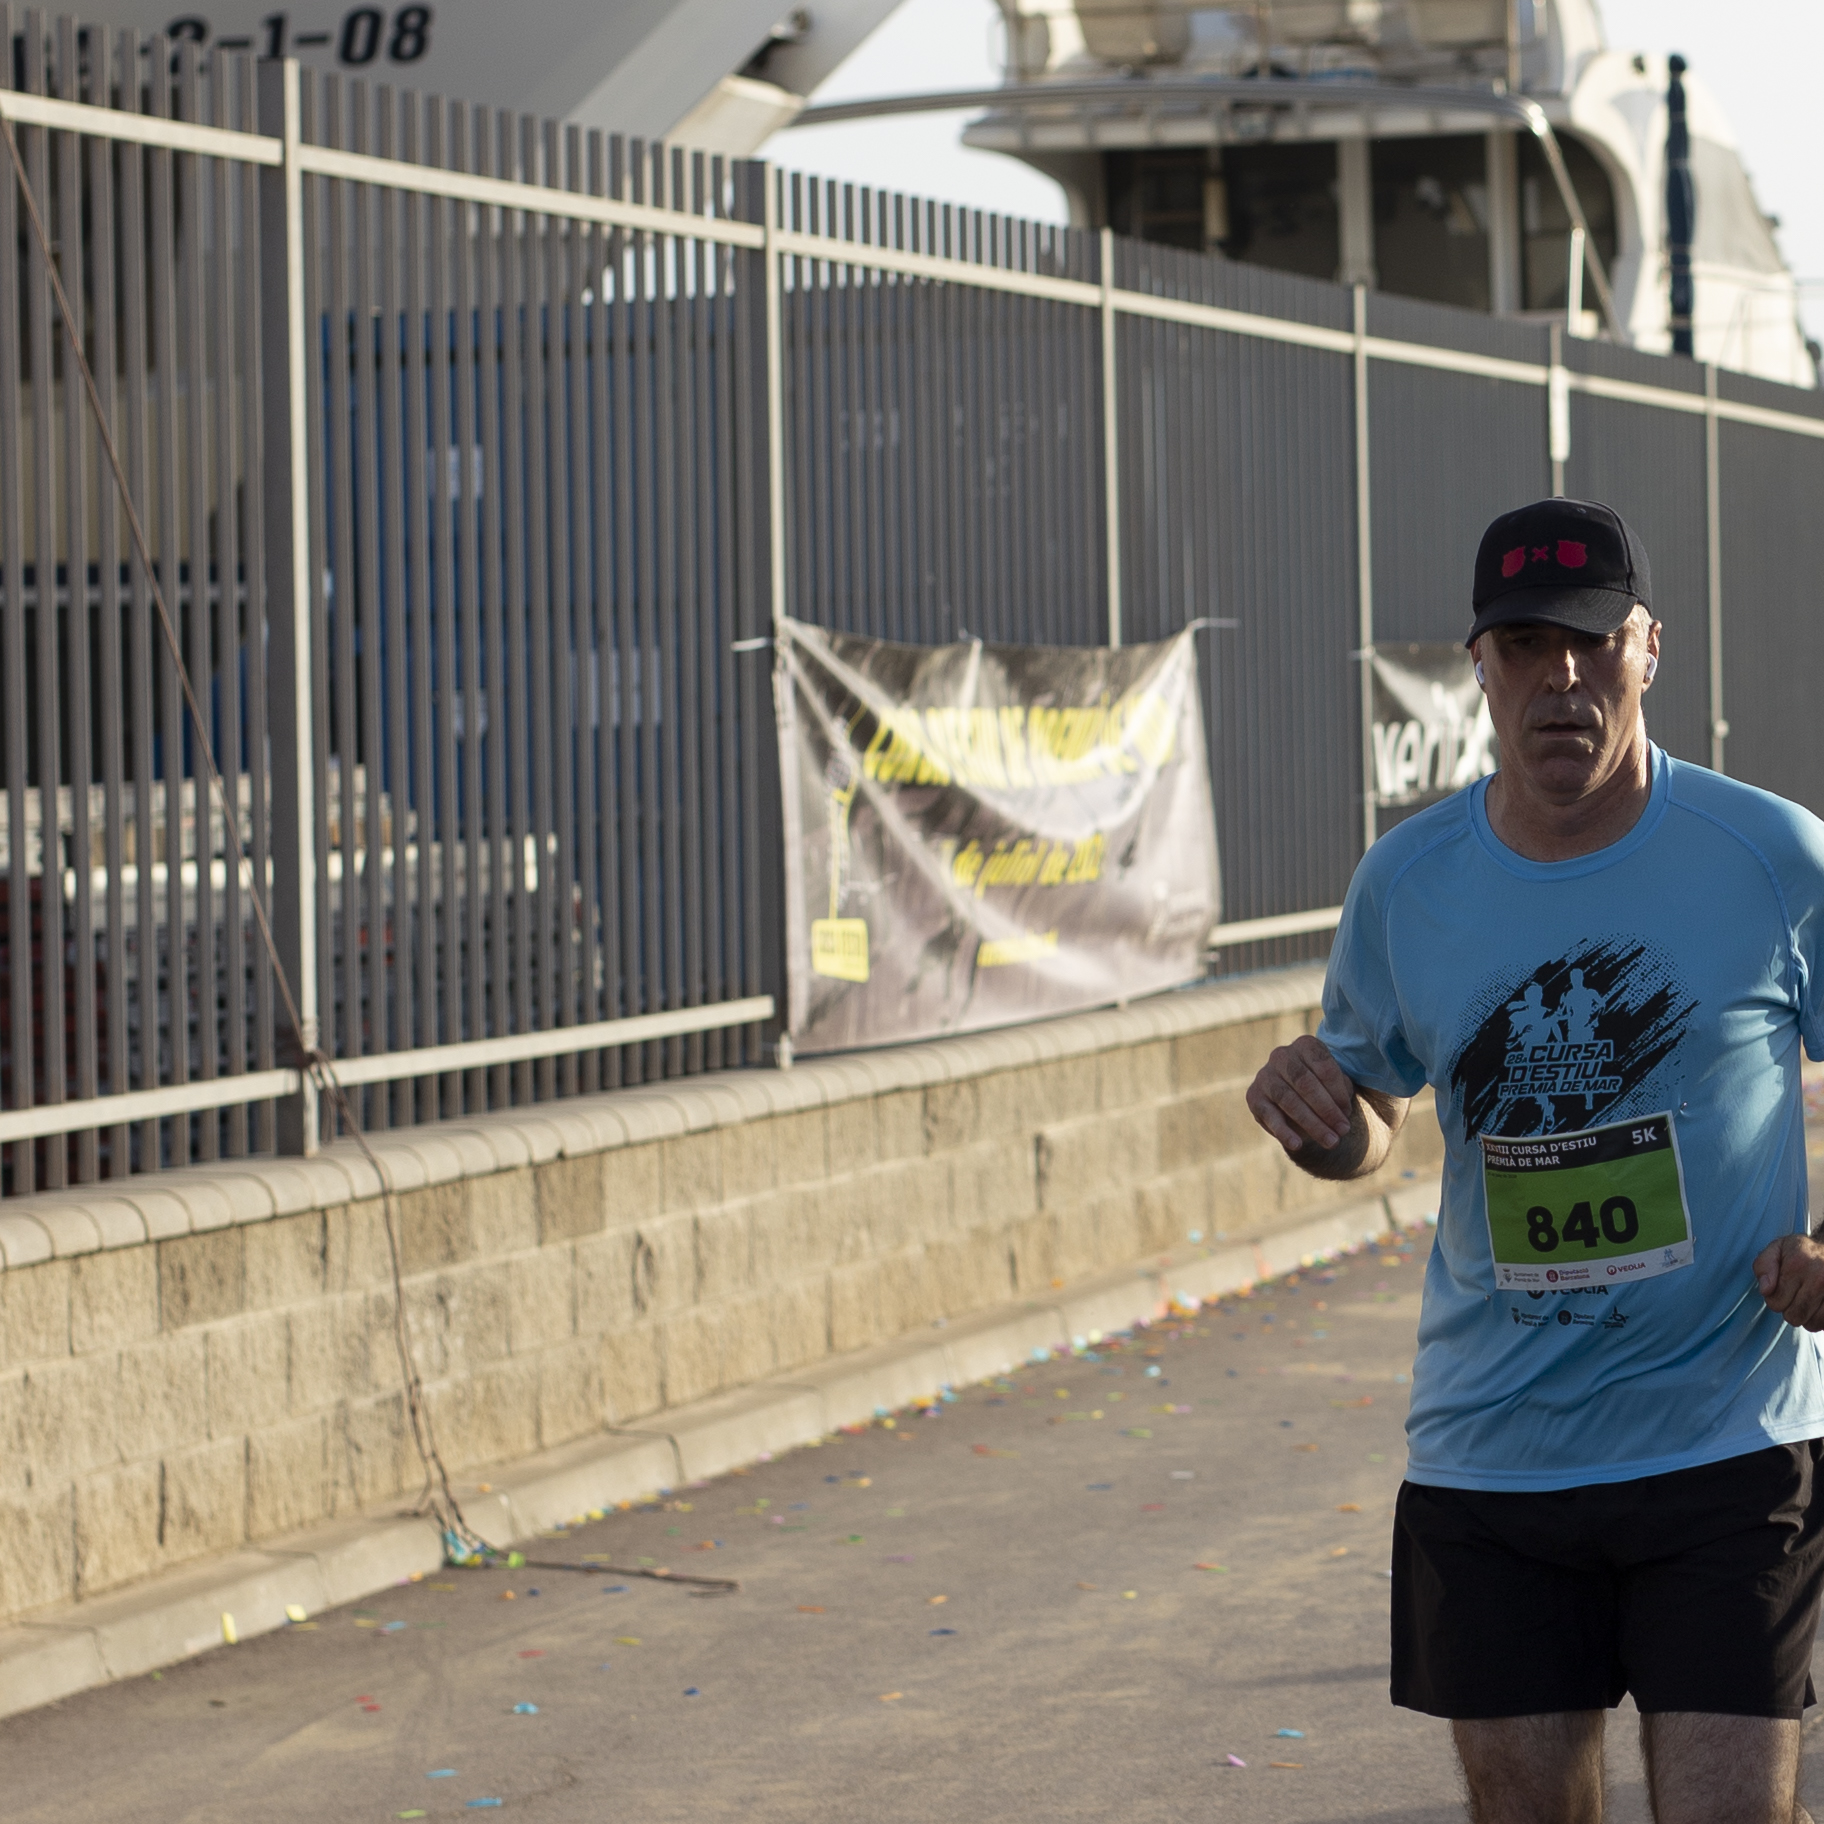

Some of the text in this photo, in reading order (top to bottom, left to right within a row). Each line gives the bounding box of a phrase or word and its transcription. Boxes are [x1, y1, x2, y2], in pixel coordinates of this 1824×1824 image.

[1528, 1041, 1612, 1064] CURSA
[1509, 1061, 1600, 1083] D'ESTIU
[1559, 1080, 1581, 1093] DE
[1583, 1078, 1621, 1092] MAR
[1511, 1145, 1547, 1156] CURSA
[1549, 1136, 1597, 1153] D'ESTIU
[1632, 1126, 1658, 1145] 5K
[1518, 1157, 1533, 1168] DE
[1535, 1155, 1561, 1167] MAR
[1526, 1195, 1639, 1252] 840
[1617, 1262, 1646, 1273] VEOLIA
